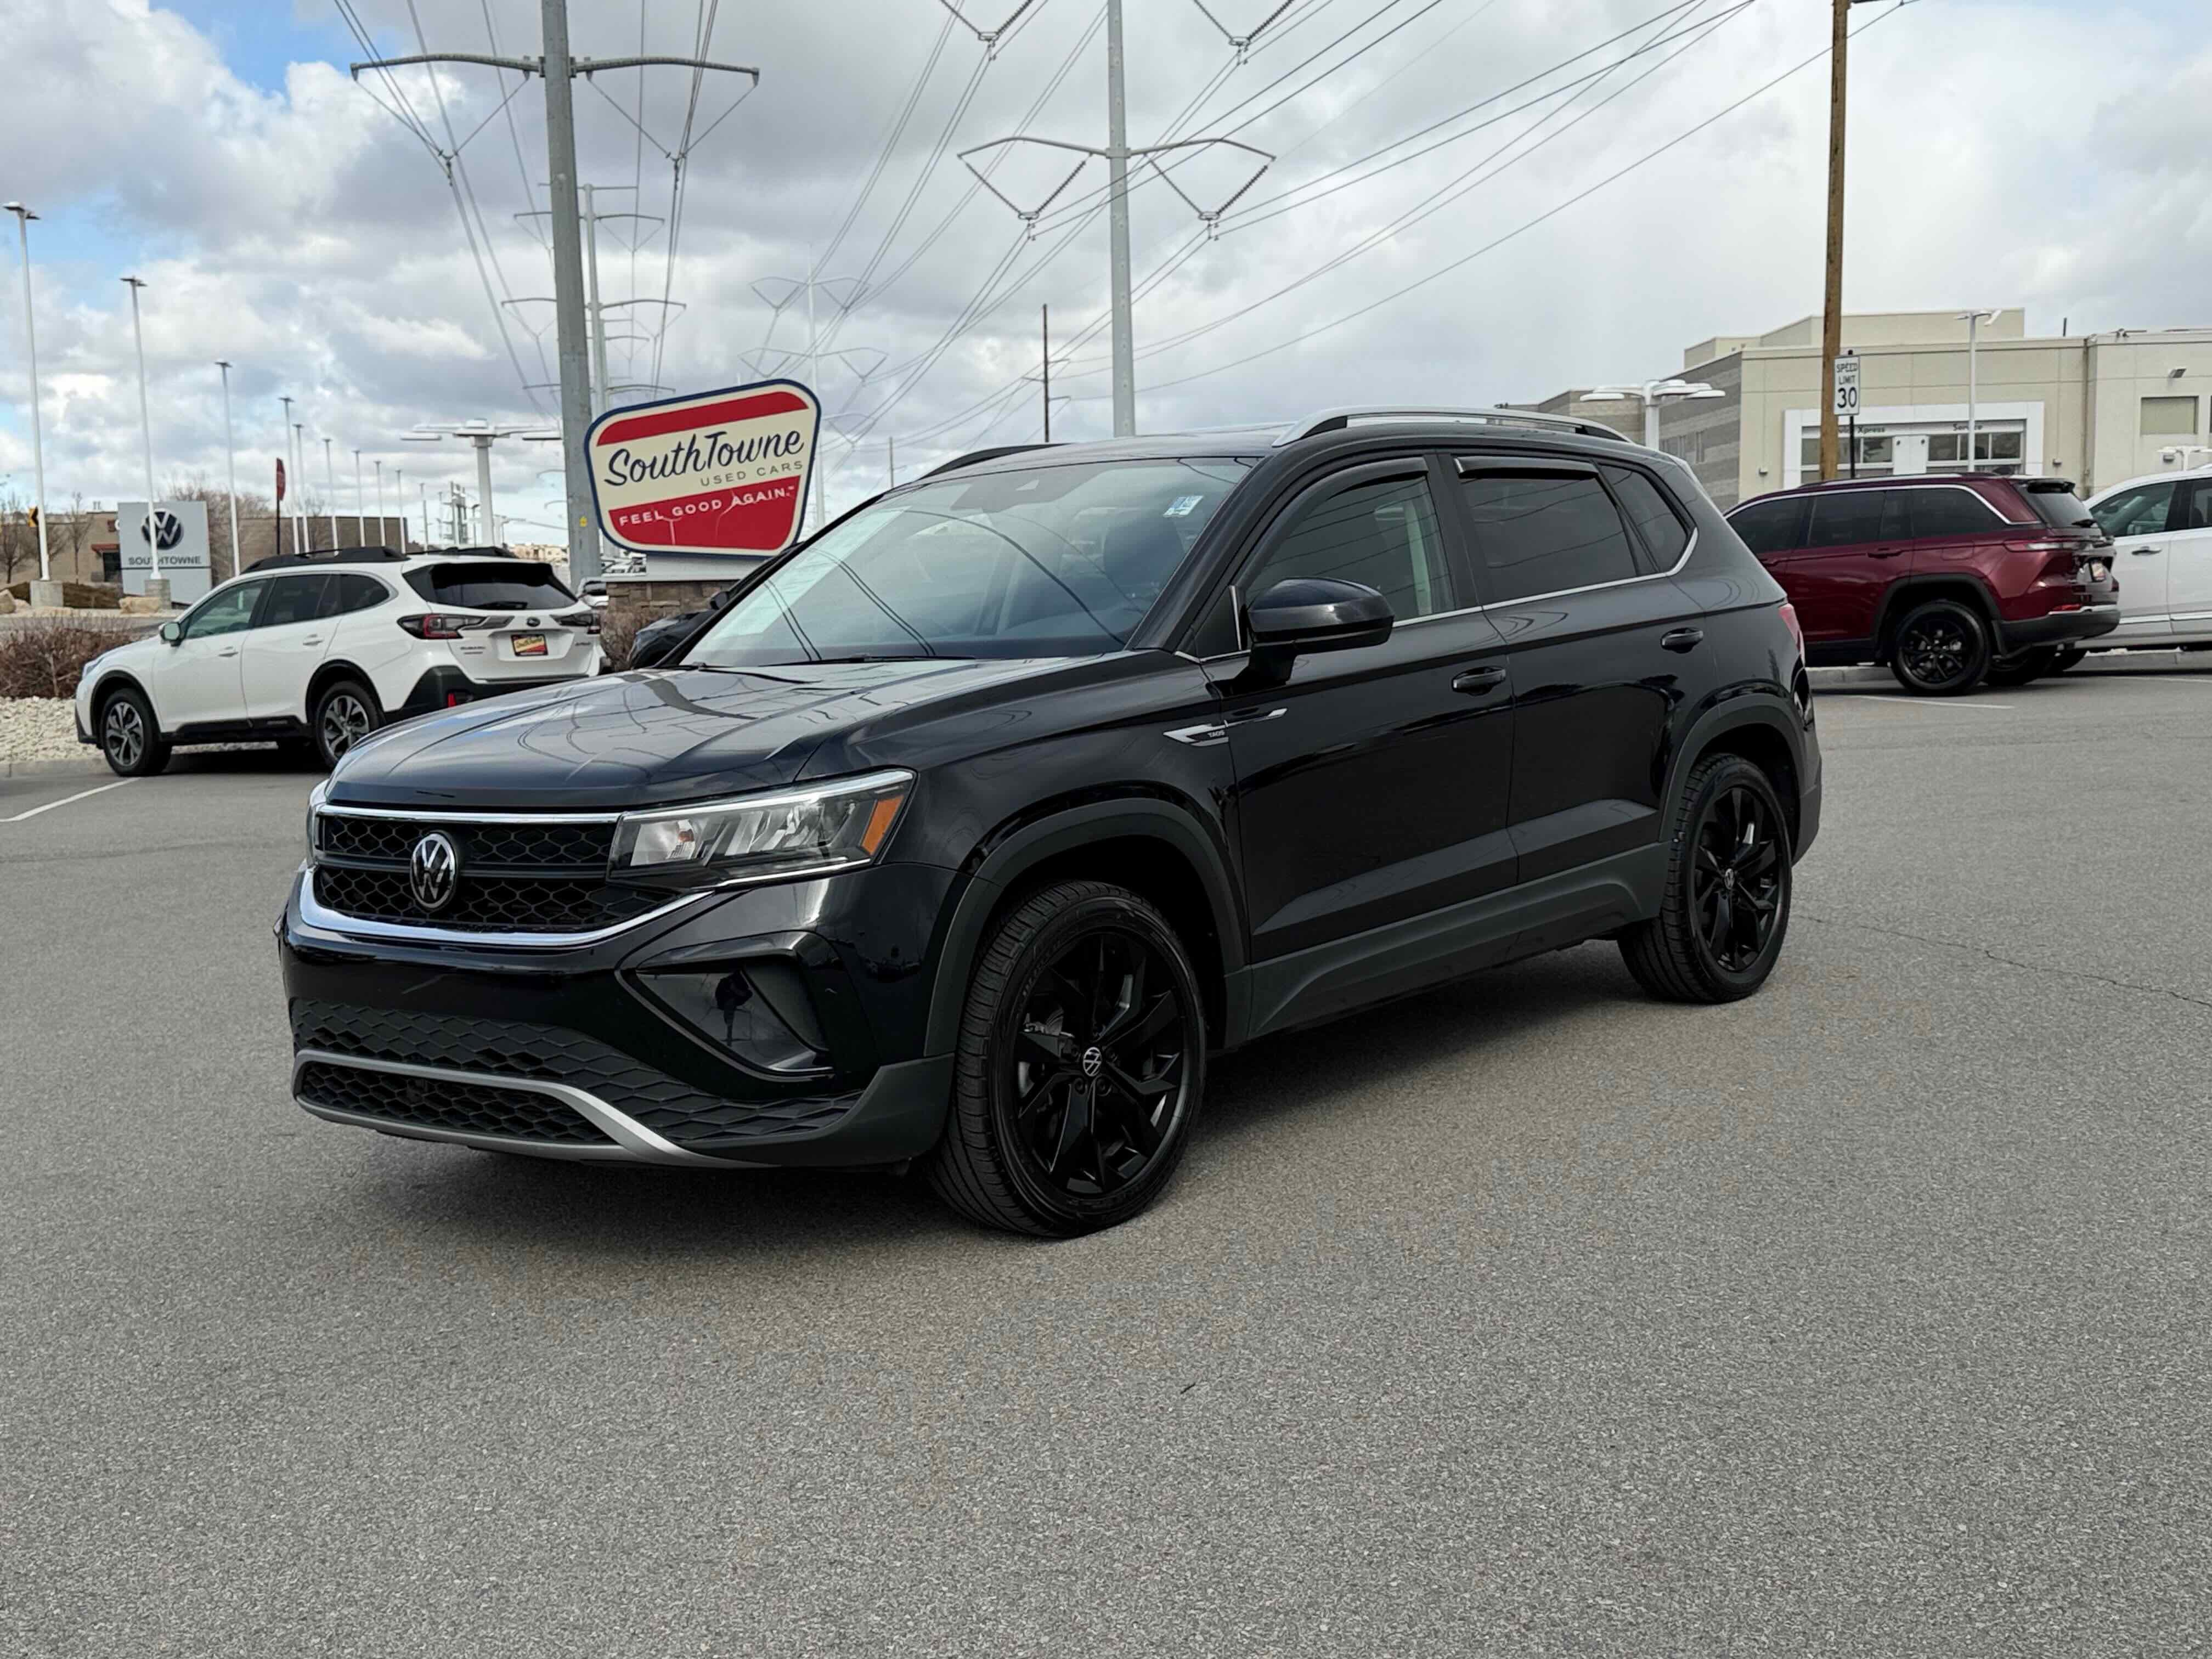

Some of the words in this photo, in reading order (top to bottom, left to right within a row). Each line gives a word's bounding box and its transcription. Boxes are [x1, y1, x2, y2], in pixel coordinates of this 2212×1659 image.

[1837, 363, 1857, 373] SPEED
[1838, 375, 1855, 385] LIMIT
[1837, 386, 1858, 409] 30
[604, 430, 804, 487] SouthTowne
[700, 470, 747, 487] USED
[756, 460, 804, 476] CARS
[619, 511, 665, 527] FEEL
[672, 499, 723, 517] GOOD
